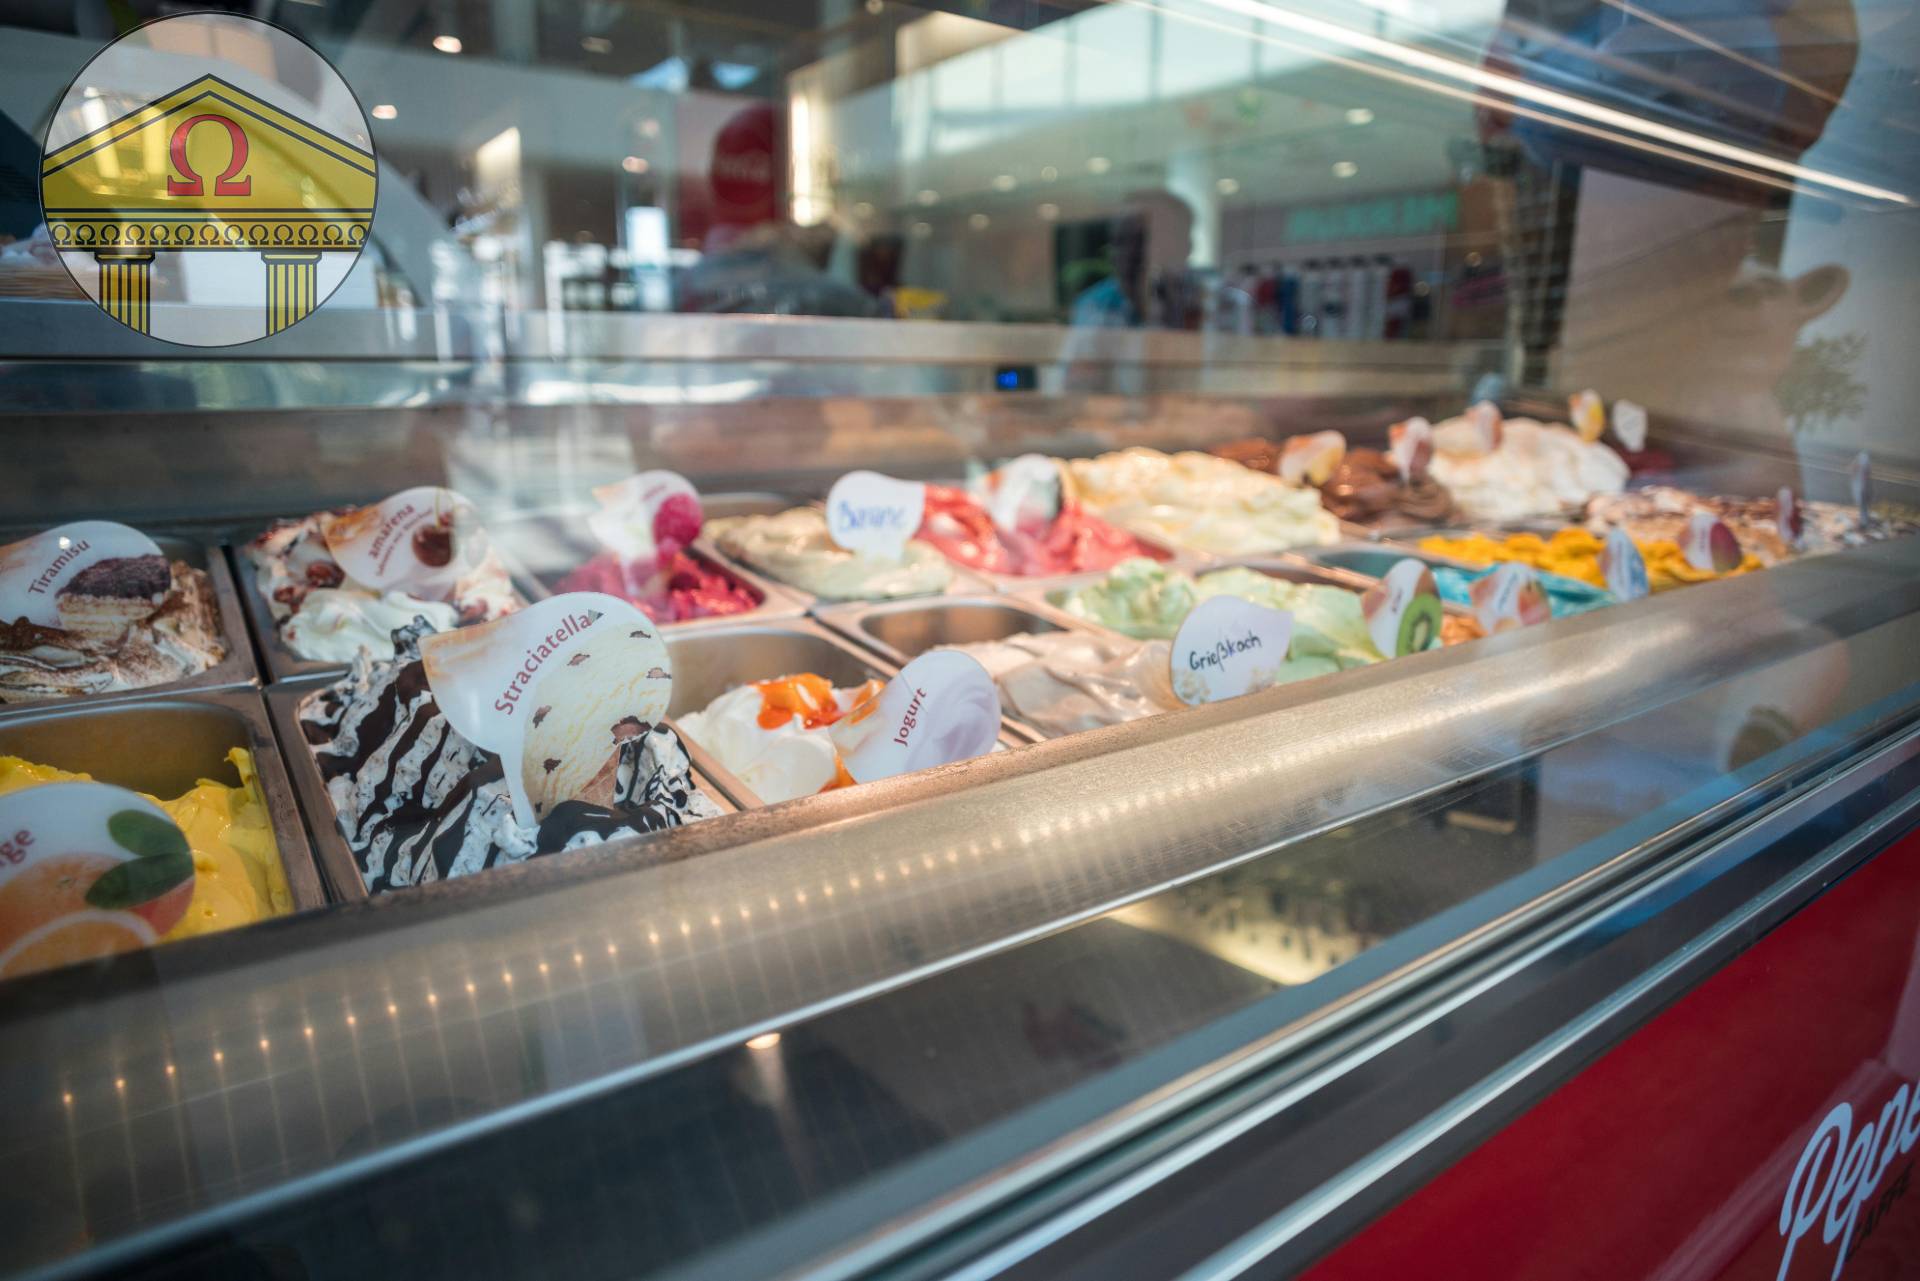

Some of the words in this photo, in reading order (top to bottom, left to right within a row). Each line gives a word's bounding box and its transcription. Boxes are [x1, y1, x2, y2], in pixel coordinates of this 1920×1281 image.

[28, 539, 91, 594] Tiramisu
[494, 612, 593, 715] Straciatella
[1189, 629, 1263, 673] Grießkoch
[893, 687, 927, 748] Jogurt
[0, 829, 36, 868] ge
